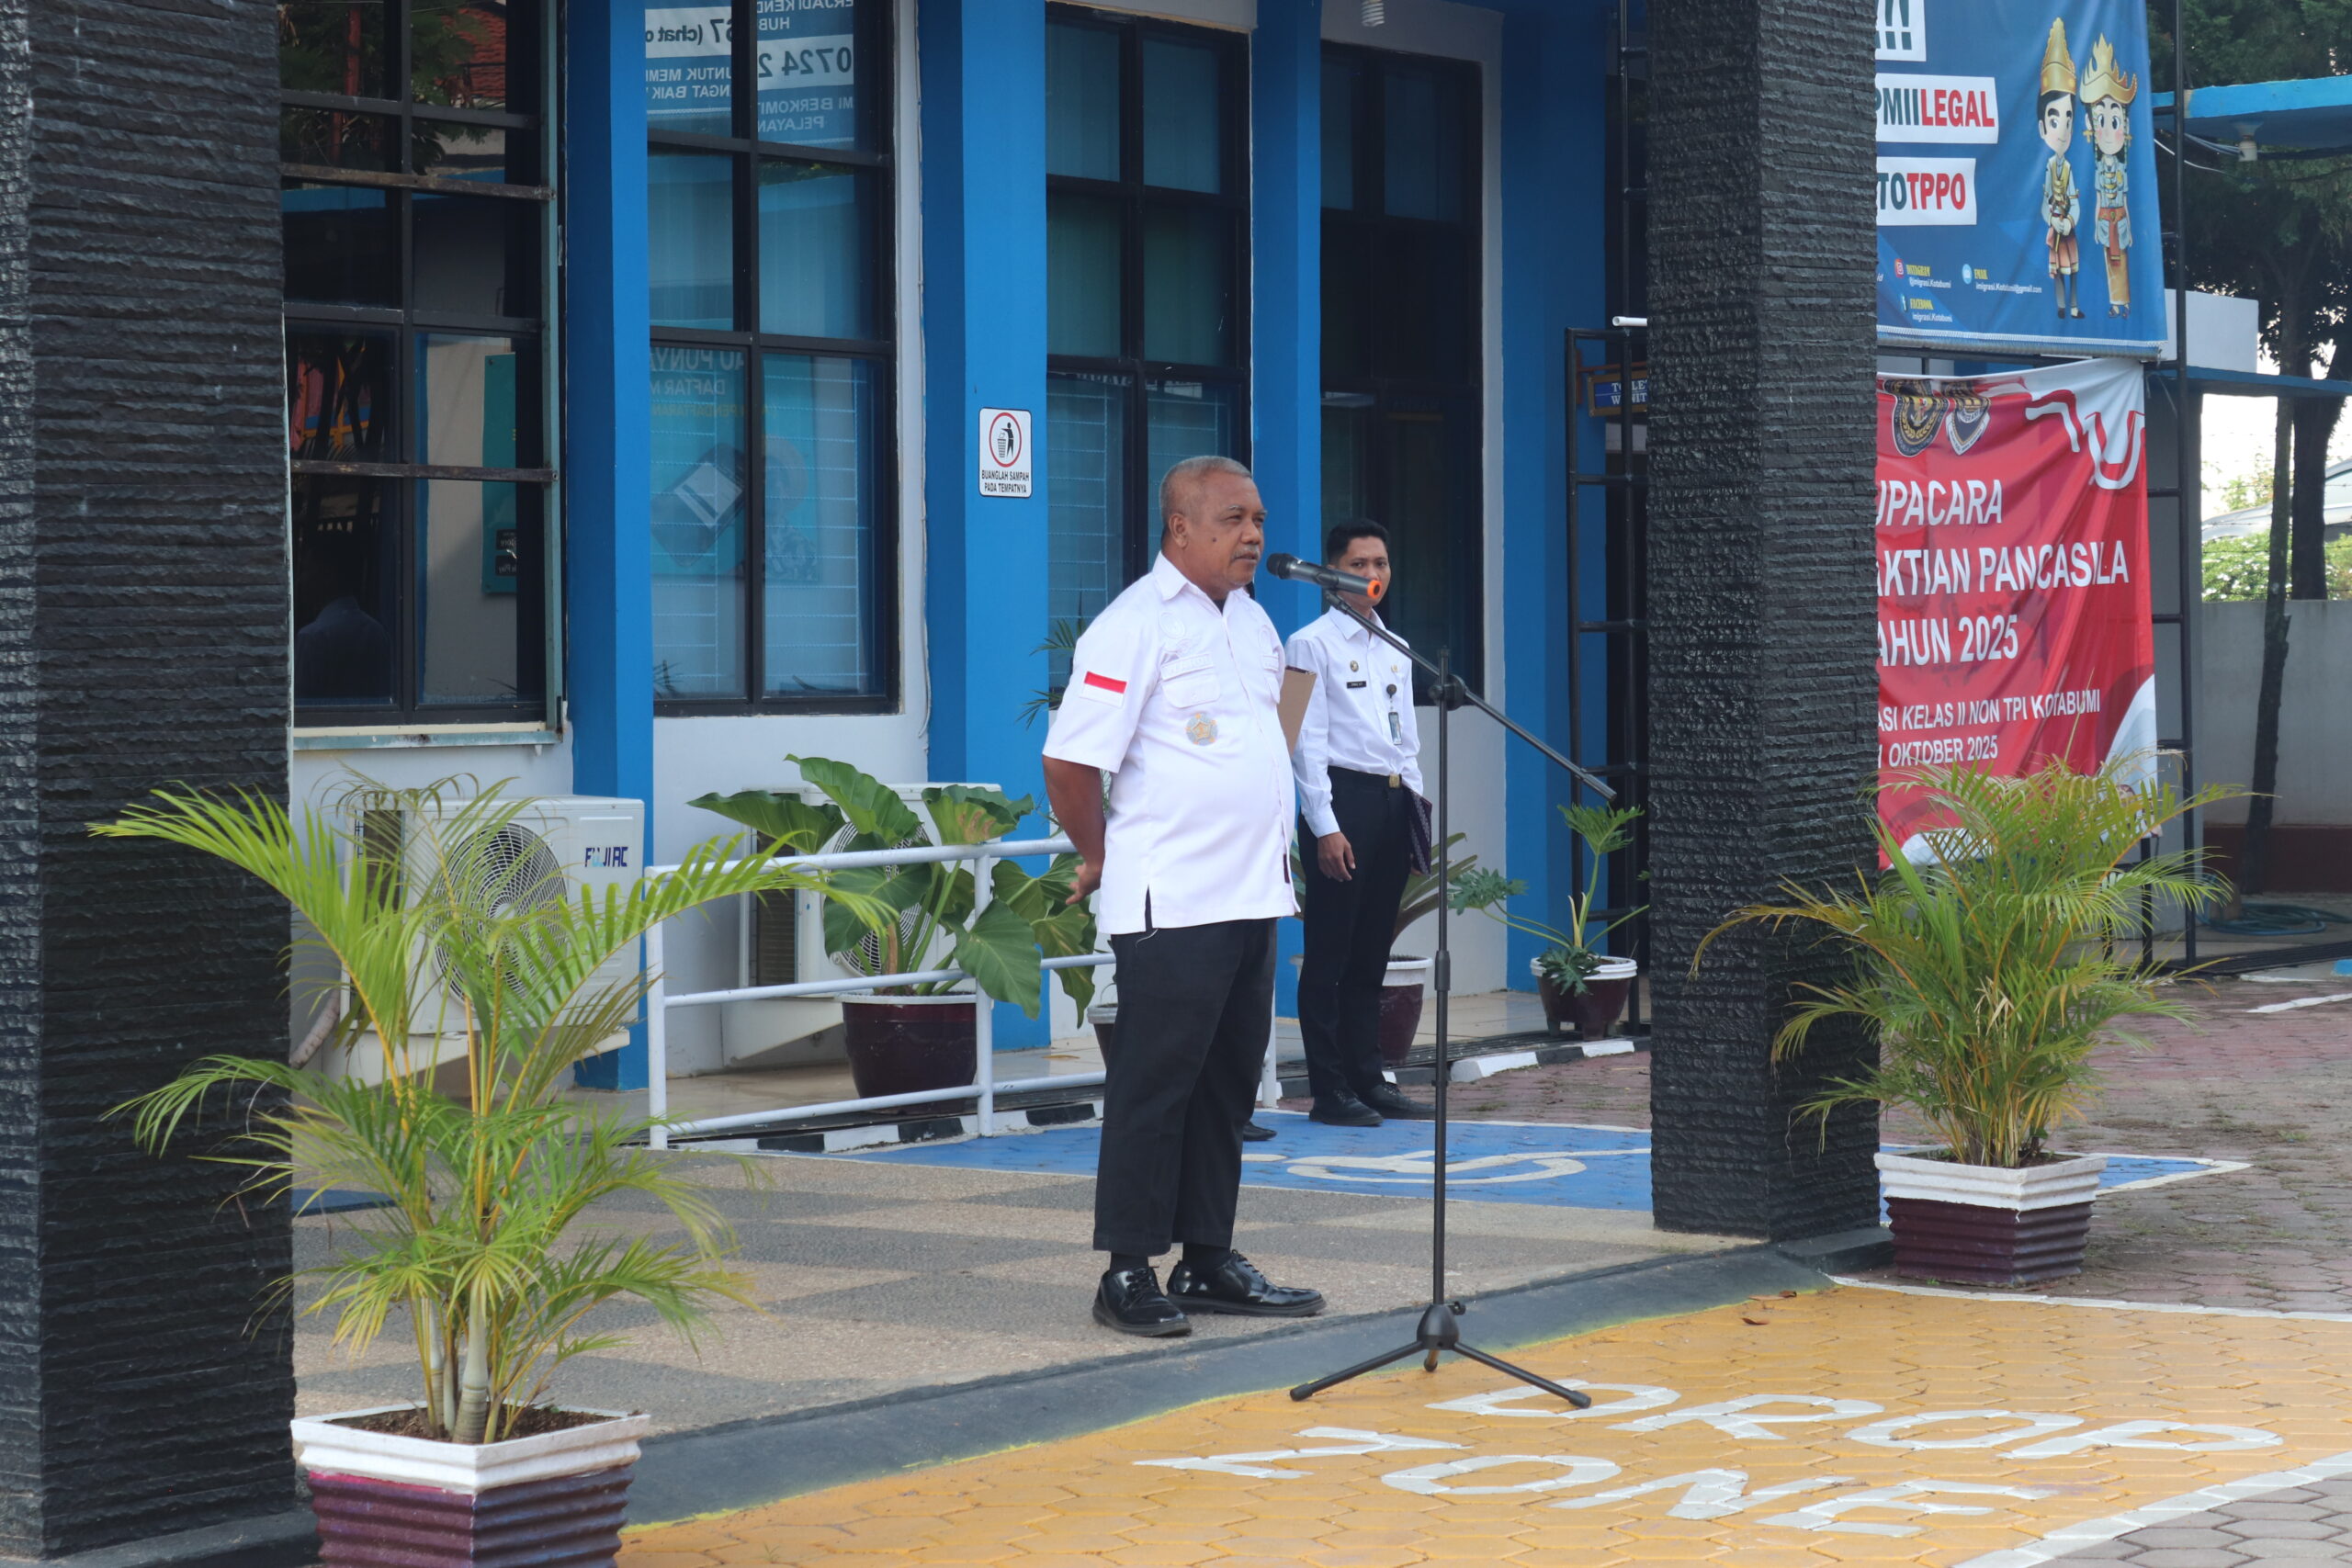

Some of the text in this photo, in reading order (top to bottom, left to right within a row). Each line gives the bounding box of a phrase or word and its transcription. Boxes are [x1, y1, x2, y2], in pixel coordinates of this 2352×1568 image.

[982, 470, 1029, 481] BUANGLAH SAMPAH
[985, 482, 1027, 493] PADA TEMPATNYA
[1979, 540, 2130, 592] PANCASILA
[1958, 614, 2018, 662] 2025
[1902, 702, 1954, 730] KELAS
[1957, 701, 1965, 726] II
[1969, 699, 2000, 725] NON
[2003, 695, 2028, 721] TPI
[2030, 689, 2100, 719] KOTABUMI
[1889, 738, 1964, 768] OKTOBER
[1967, 735, 1998, 761] 2025
[1425, 1379, 2284, 1459] DROP
[1133, 1426, 2060, 1538] ZONE
